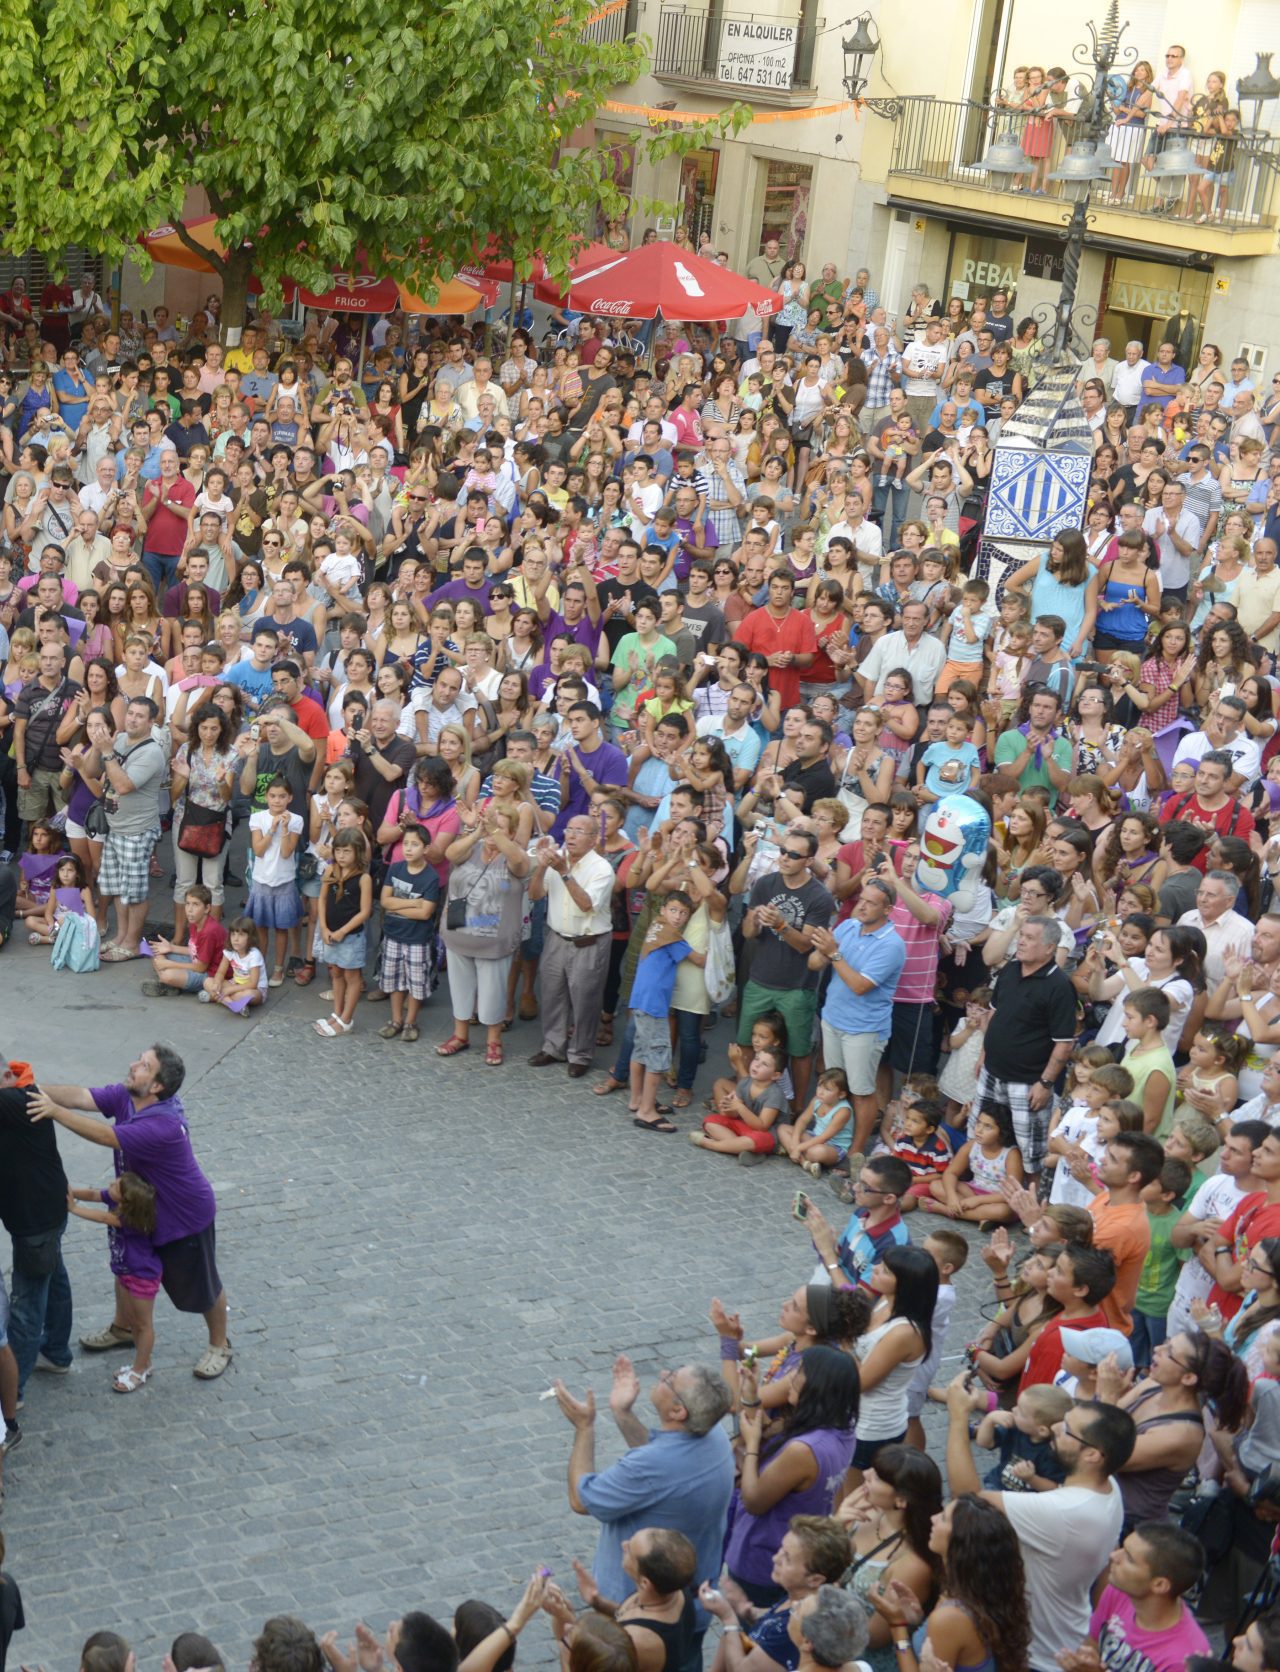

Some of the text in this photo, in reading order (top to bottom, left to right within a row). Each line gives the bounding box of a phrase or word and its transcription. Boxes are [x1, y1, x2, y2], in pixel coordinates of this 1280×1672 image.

[727, 23, 793, 41] EN ALQUILER
[727, 52, 755, 65] OFICINA
[763, 56, 774, 67] 100
[775, 58, 787, 68] m2
[720, 65, 735, 80] Tel.
[738, 67, 754, 82] 647
[757, 69, 773, 84] 531
[335, 296, 367, 308] FRIGO
[590, 298, 635, 315] Coca-Cola
